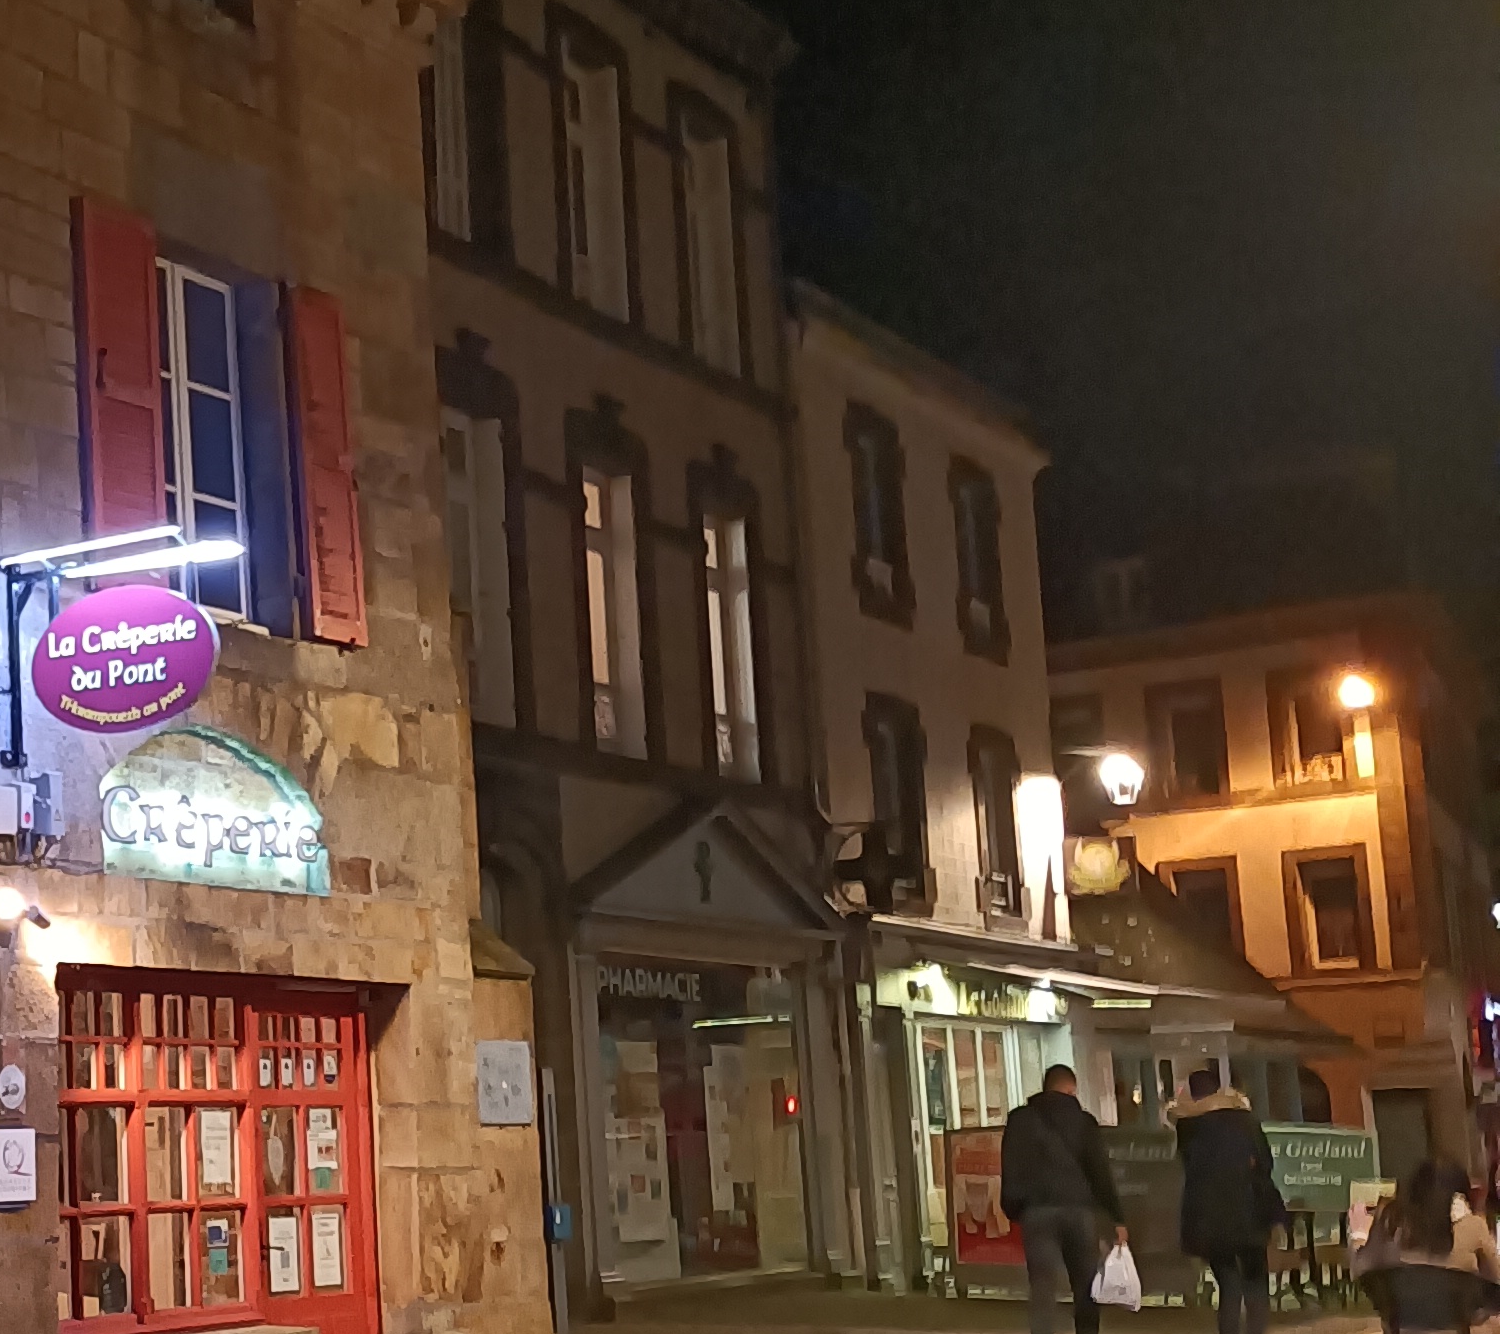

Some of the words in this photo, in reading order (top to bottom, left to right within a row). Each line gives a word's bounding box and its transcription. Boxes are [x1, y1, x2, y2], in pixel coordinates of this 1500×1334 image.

[47, 631, 76, 659] La
[107, 656, 167, 688] Pont
[102, 785, 321, 867] Crêperie
[597, 966, 701, 1002] PHARMACIE
